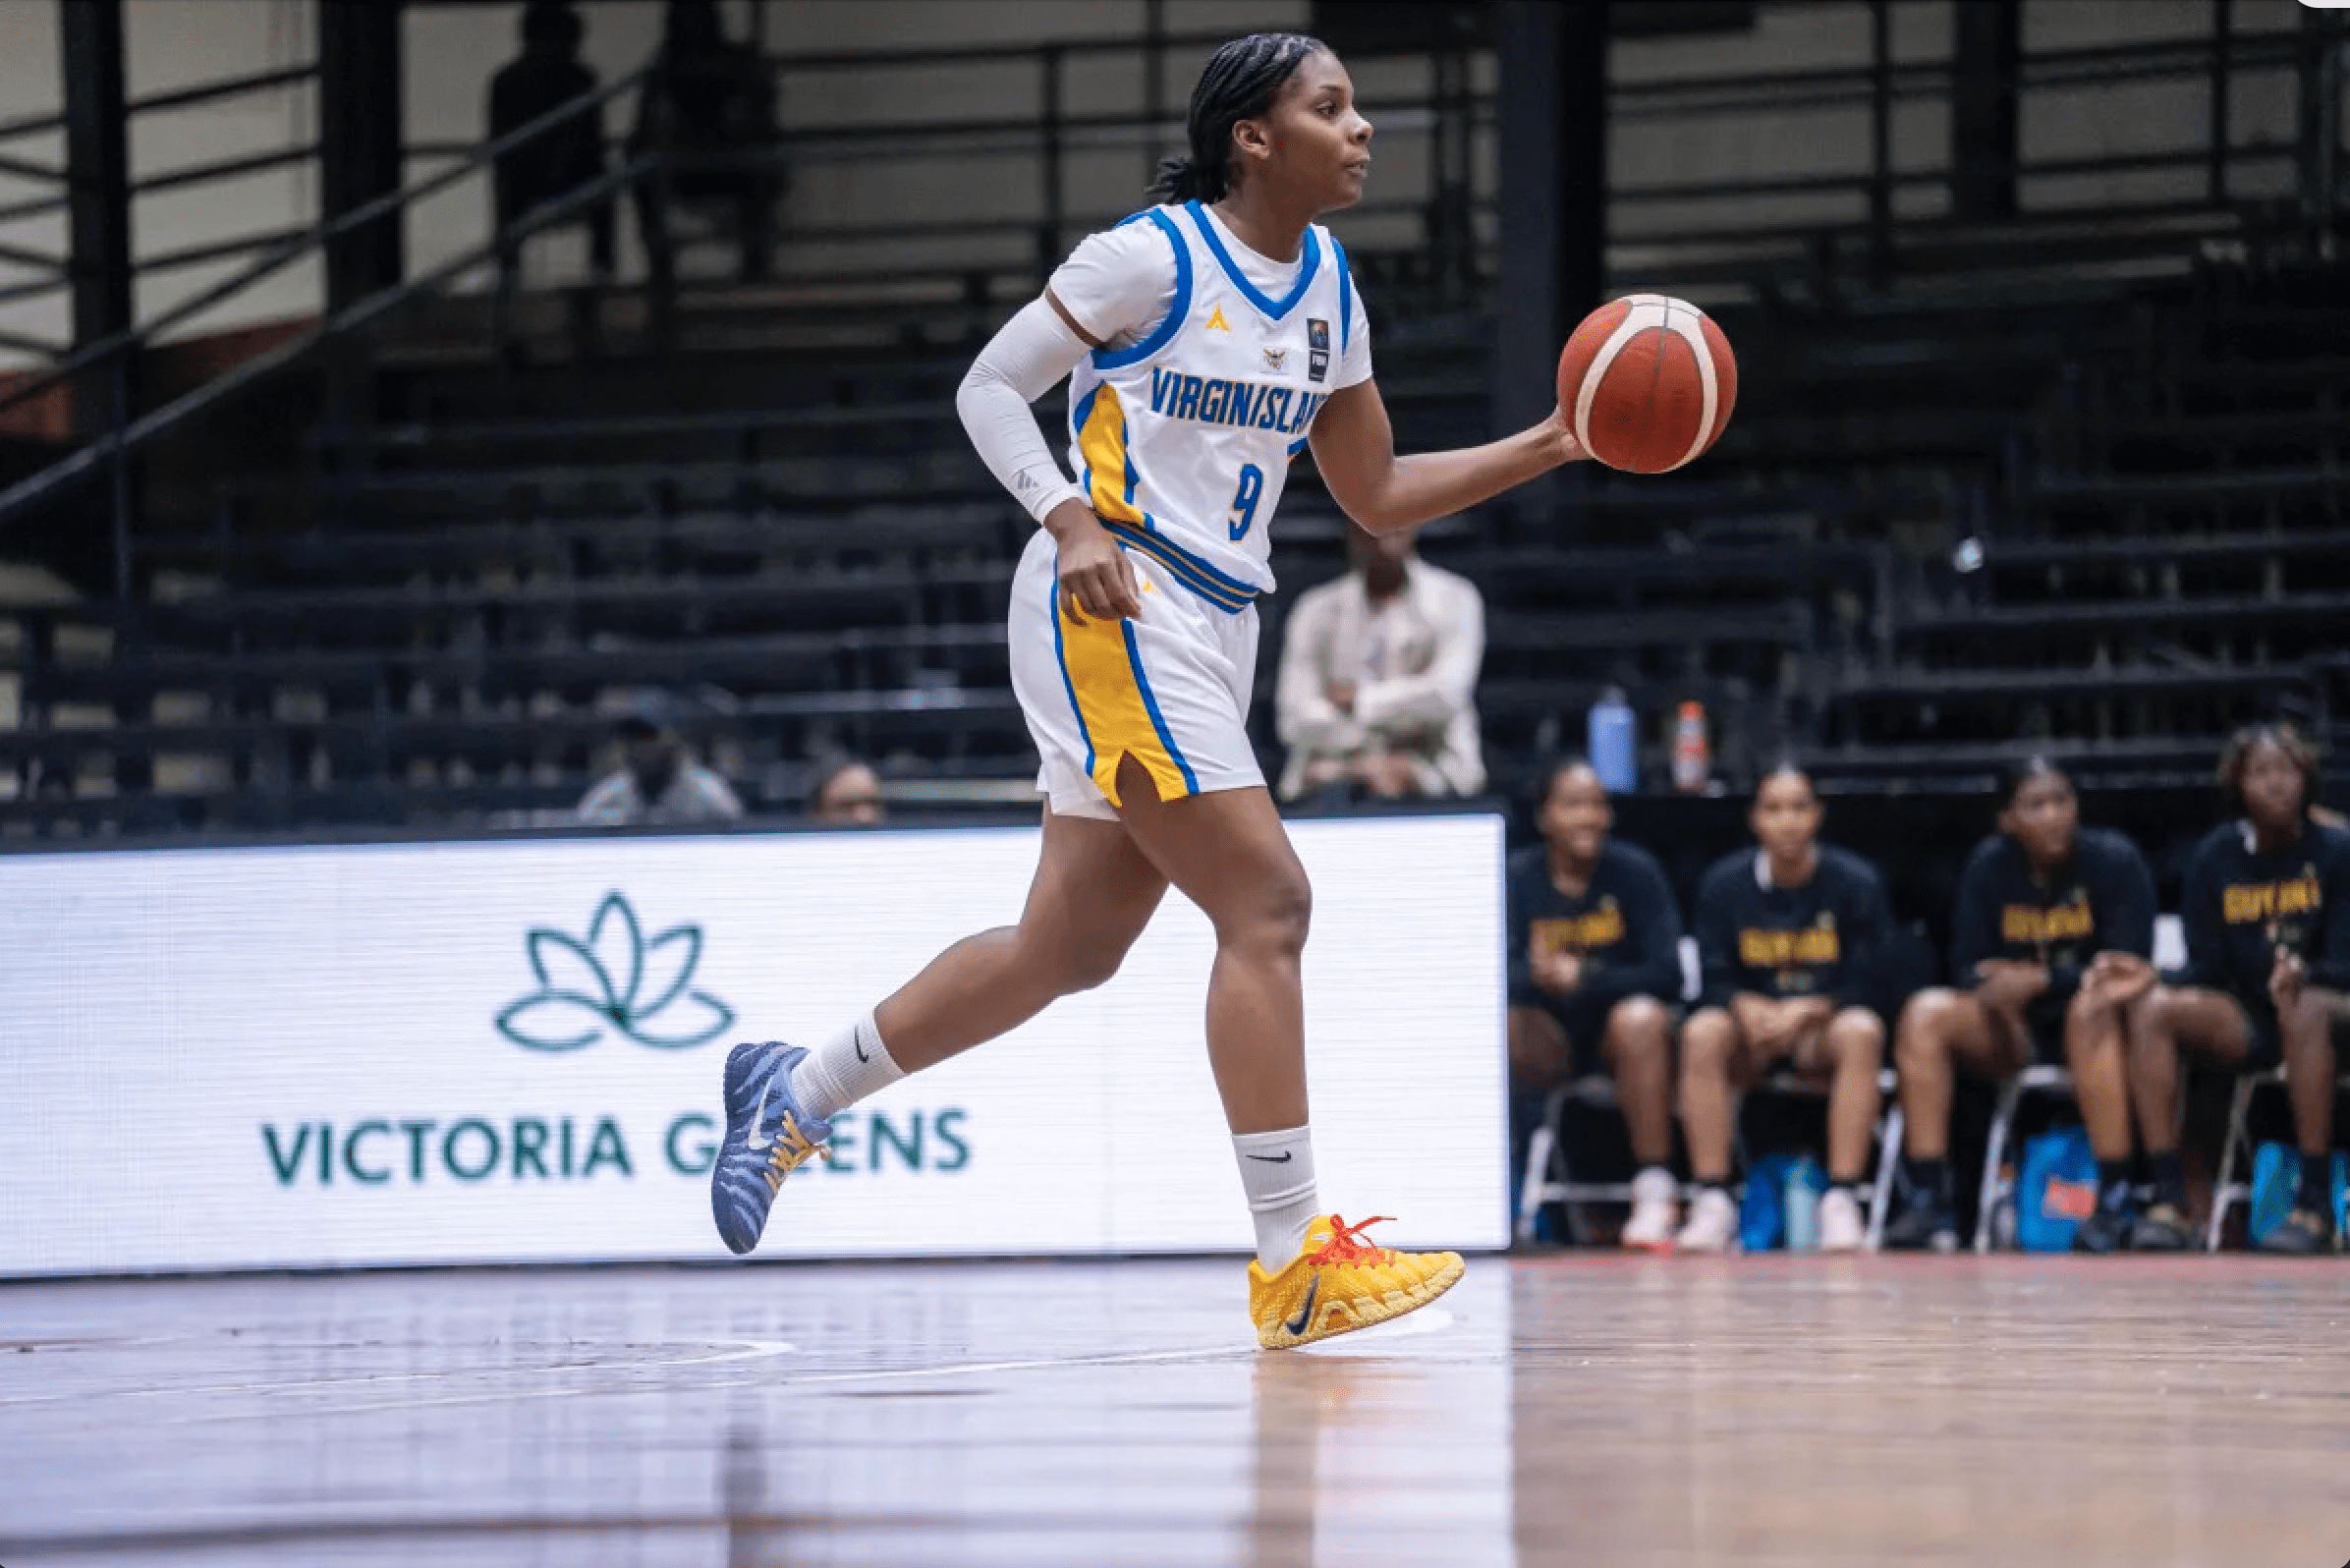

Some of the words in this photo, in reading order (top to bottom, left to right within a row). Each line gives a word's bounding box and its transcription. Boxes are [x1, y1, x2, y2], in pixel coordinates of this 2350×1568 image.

[1228, 462, 1264, 542] 9
[261, 1115, 634, 1187] VICTORIA
[662, 1107, 971, 1177] GENS
